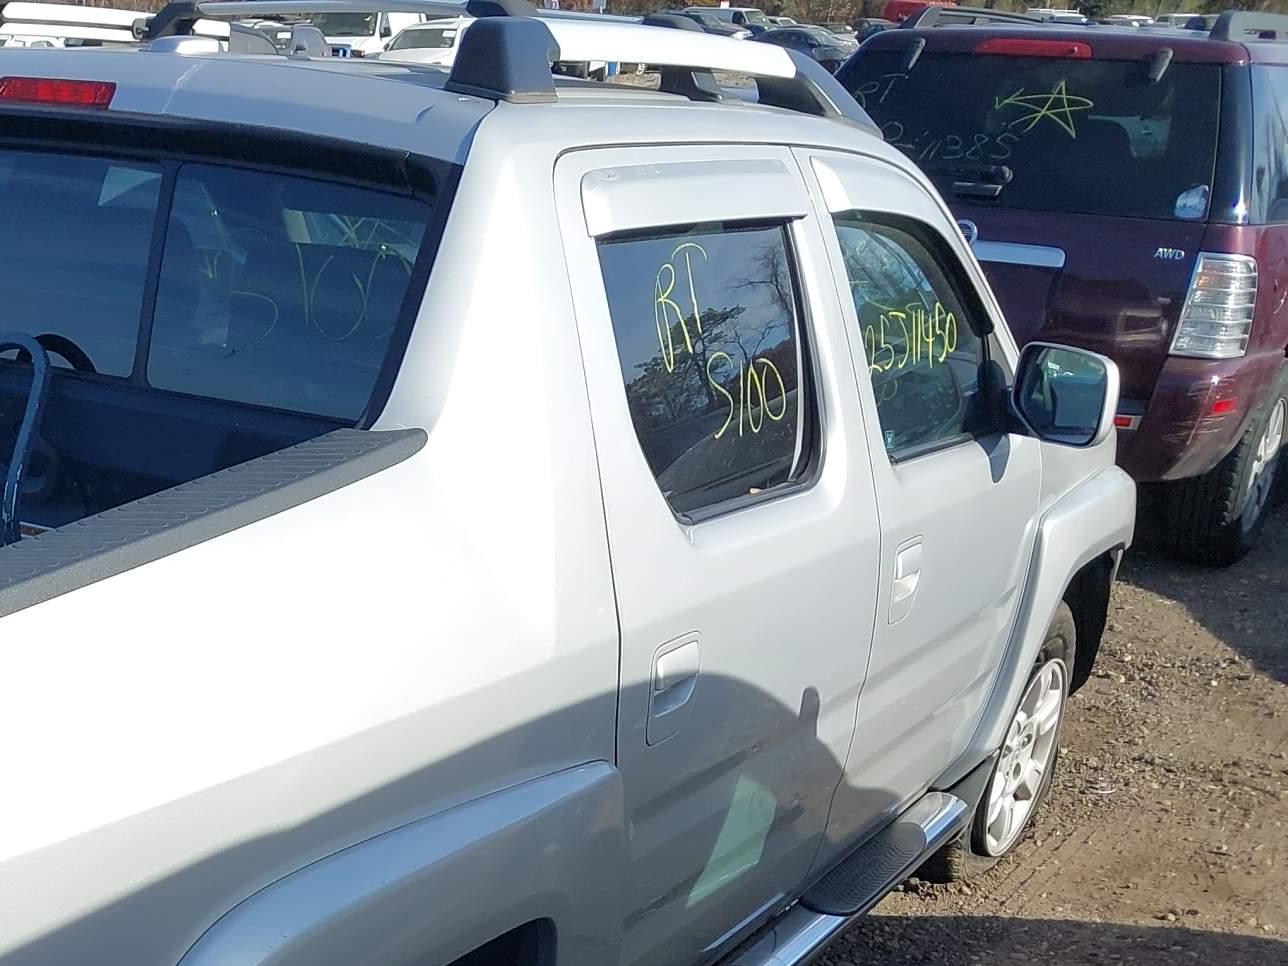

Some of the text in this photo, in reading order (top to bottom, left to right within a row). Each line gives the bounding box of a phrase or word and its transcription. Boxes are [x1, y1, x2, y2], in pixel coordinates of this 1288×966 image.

[1153, 247, 1185, 260] AWD
[654, 242, 708, 373] RT
[865, 302, 958, 373] 25J11450
